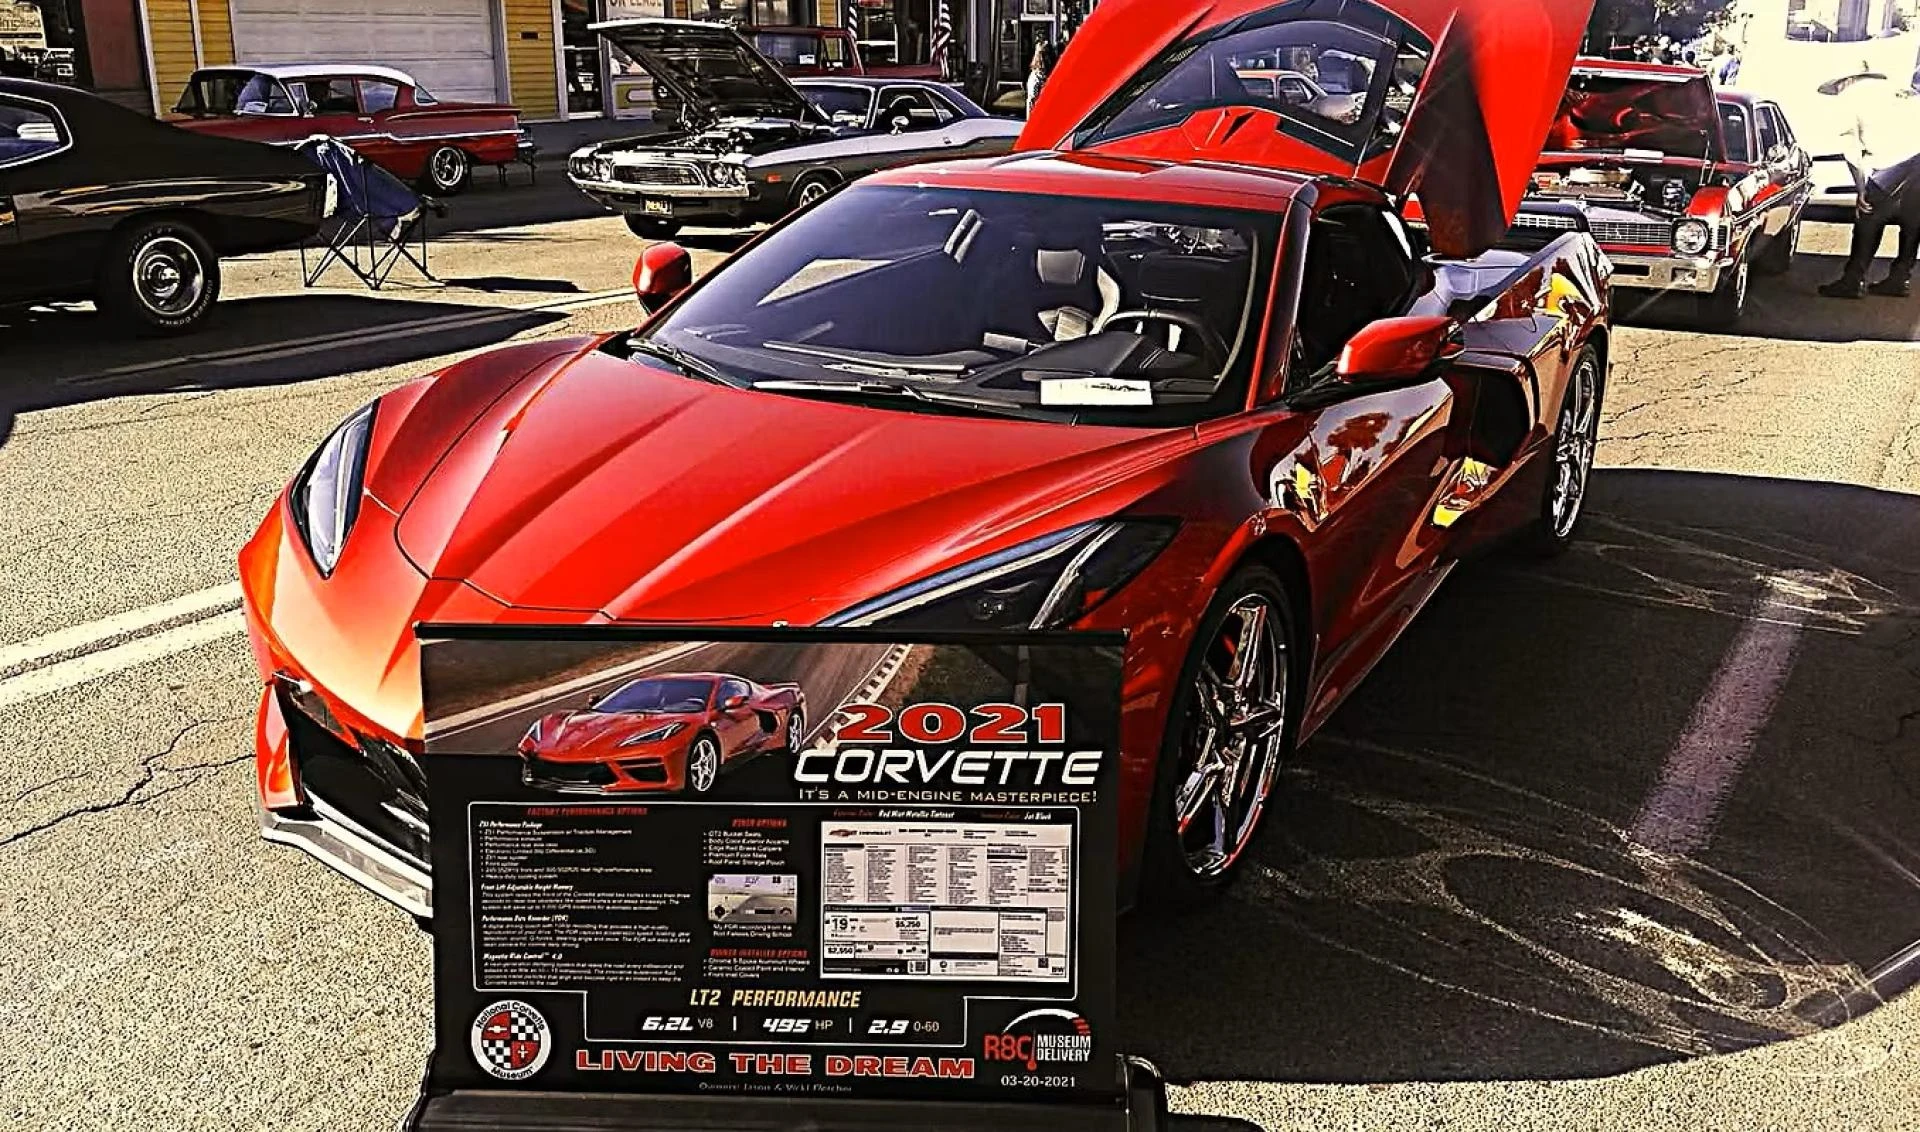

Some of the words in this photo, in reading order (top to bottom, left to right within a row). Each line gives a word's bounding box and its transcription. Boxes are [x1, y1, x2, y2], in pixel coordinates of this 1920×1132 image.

[836, 702, 1066, 744] 2021
[794, 749, 1104, 785] CORVETTE
[800, 788, 829, 800] IT'S
[837, 790, 849, 800] A
[857, 790, 963, 801] MID-ENGINE
[970, 790, 1097, 803] MASTERPIECE!
[690, 989, 721, 1006] LT2
[732, 990, 861, 1008] PERFORMANCE
[475, 1002, 510, 1029] National
[641, 1016, 694, 1031] 6.2L
[698, 1018, 713, 1029] V8
[762, 1018, 812, 1033] 495
[815, 1019, 834, 1031] HP
[868, 1019, 909, 1034] 2.9
[913, 1021, 940, 1033] 0-60
[983, 1033, 1031, 1061] R8C
[1037, 1034, 1091, 1048] MUSEUM
[1037, 1048, 1091, 1062] DELIVERY
[576, 1049, 716, 1074] LIVING
[729, 1053, 812, 1075] THE
[826, 1055, 975, 1079] DREAM
[1000, 1075, 1076, 1088] 03-20-2021
